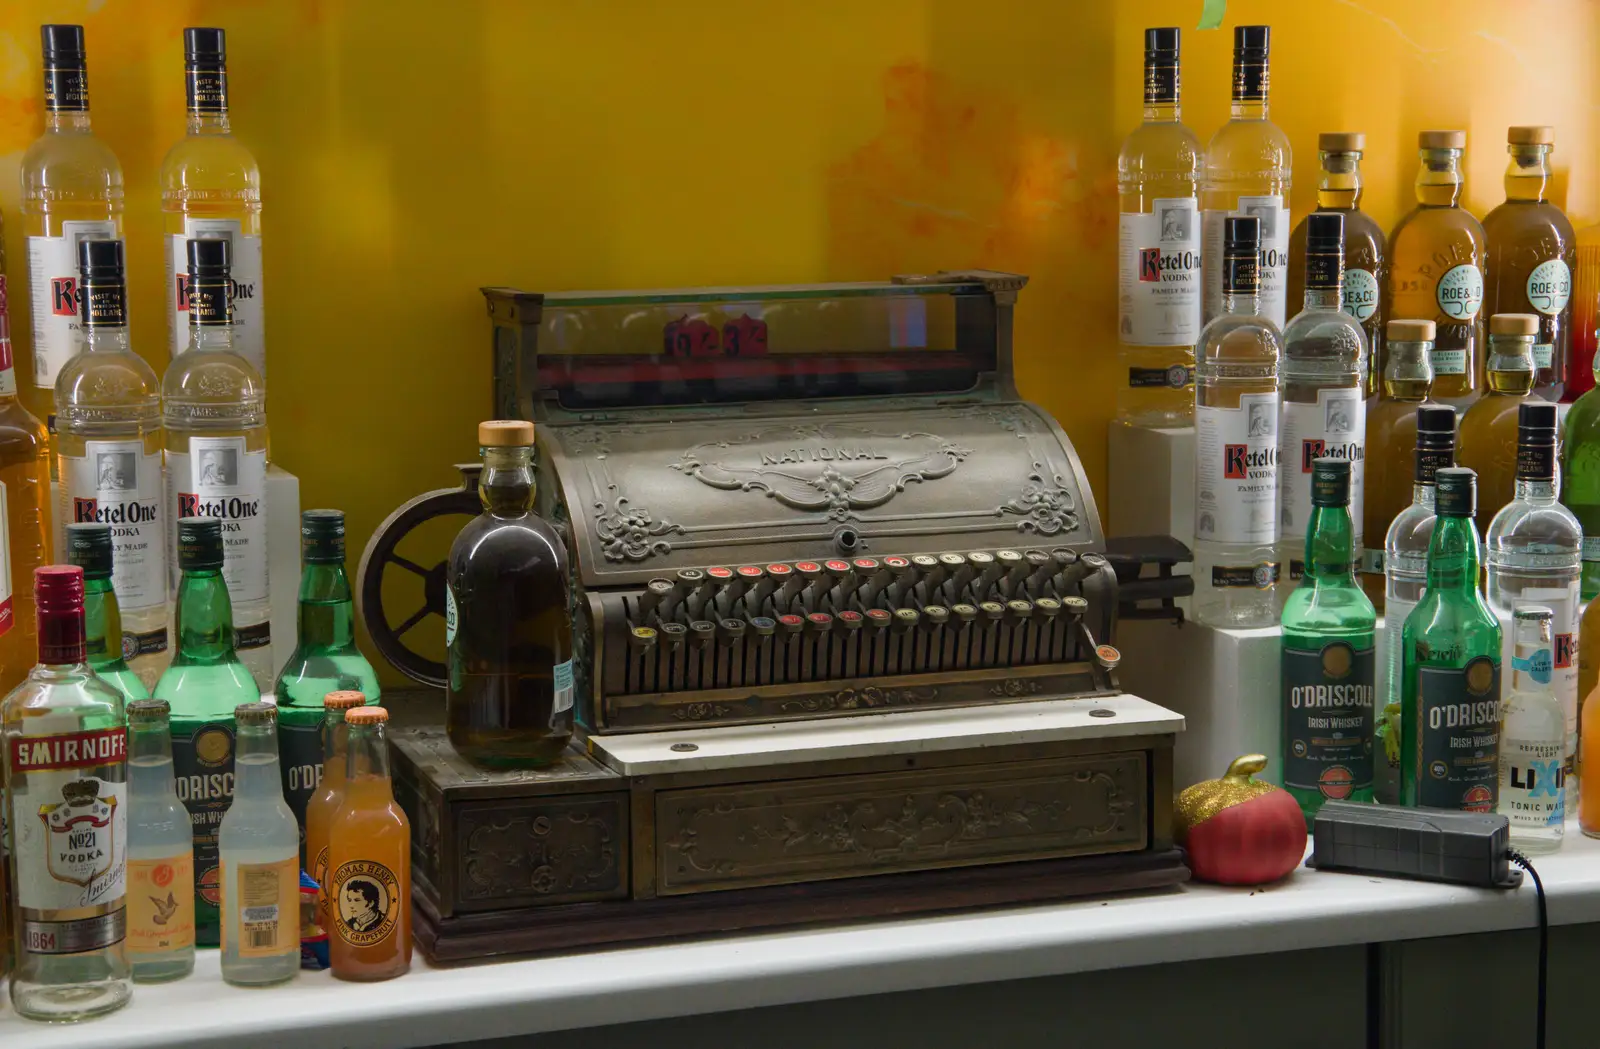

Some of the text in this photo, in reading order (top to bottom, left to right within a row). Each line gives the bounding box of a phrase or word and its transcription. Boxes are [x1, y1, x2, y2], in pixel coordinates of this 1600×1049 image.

[1142, 251, 1183, 280] Ketel
[1442, 286, 1481, 300] ROE&O
[759, 447, 888, 465] NATIONAL
[1228, 447, 1269, 477] Ketel
[77, 501, 157, 524] Ketel One
[180, 496, 258, 519] Ketel One
[124, 542, 149, 552] MADE
[1308, 716, 1364, 729] IRISH WHISKEY
[18, 734, 125, 766] SMIRNOFF
[1450, 737, 1472, 749] IRISH
[1511, 801, 1541, 812] TONIC
[60, 849, 103, 863] VODKA
[335, 863, 395, 886] THOMAS HENRY
[336, 918, 393, 942] PINK GRAPEFRUIT
[28, 932, 56, 950] 1864
